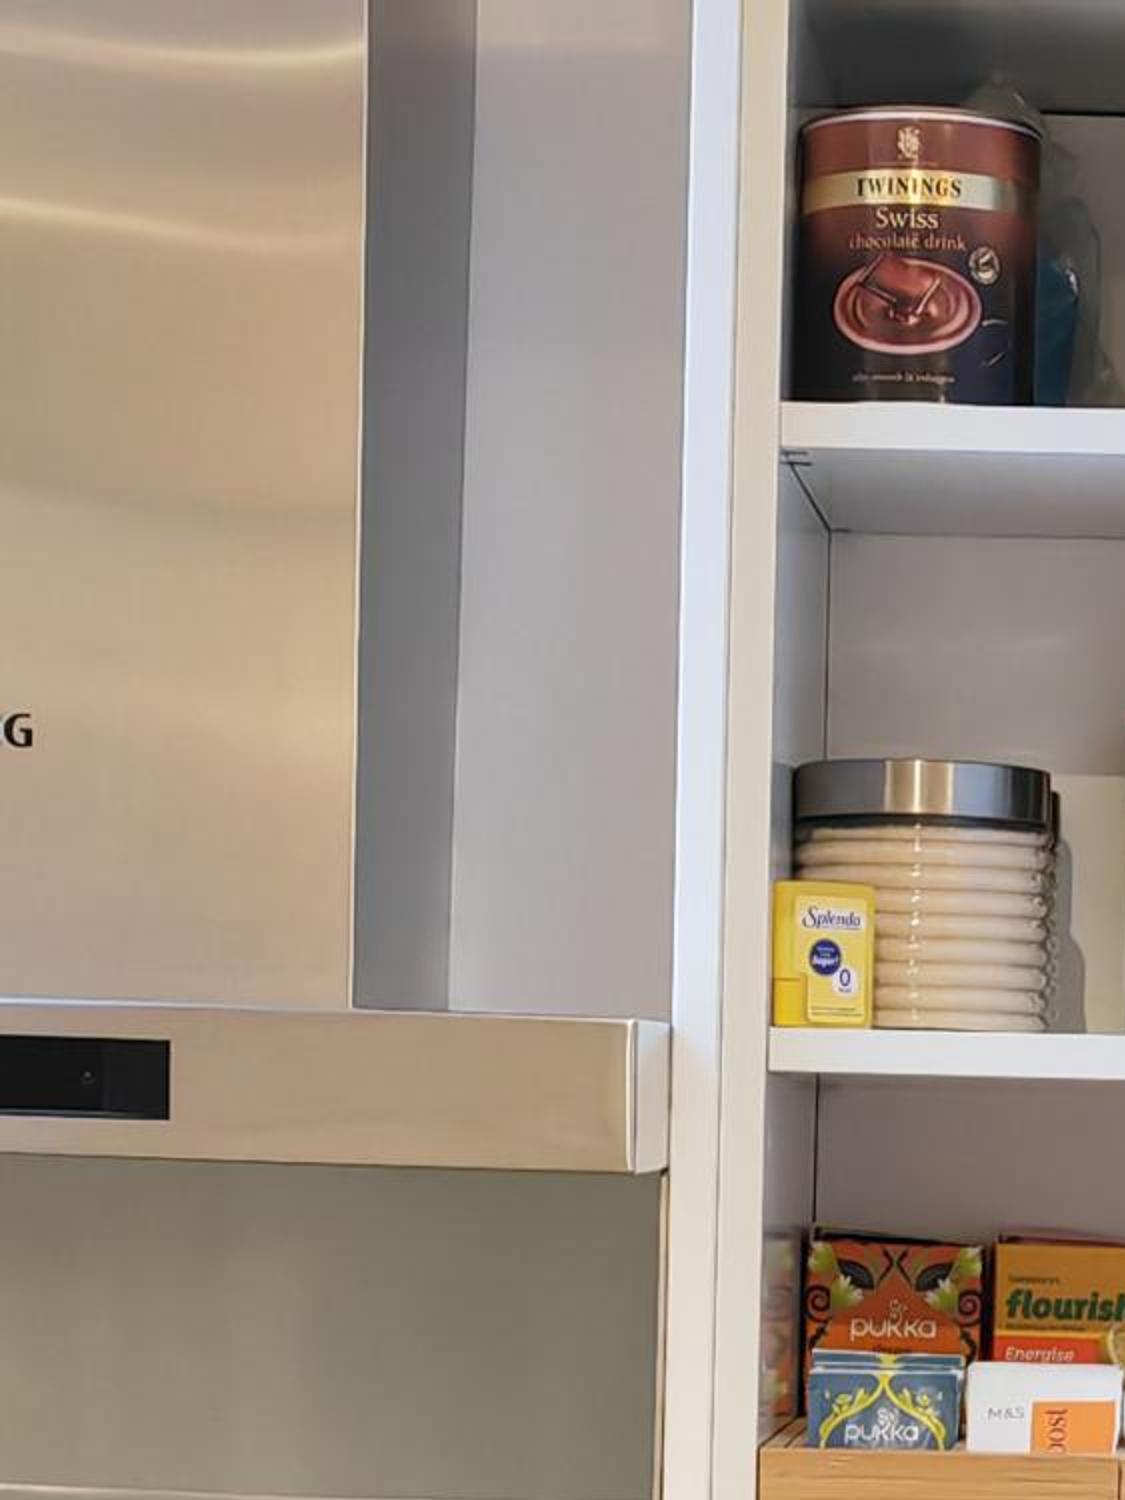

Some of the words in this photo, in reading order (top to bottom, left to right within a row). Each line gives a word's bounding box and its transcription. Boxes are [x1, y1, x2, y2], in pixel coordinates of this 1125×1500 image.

[857, 176, 962, 199] TWININGS
[875, 206, 939, 230] Swiss
[924, 233, 967, 252] drink
[803, 906, 861, 929] Splenda
[850, 1317, 937, 1342] pukka
[1005, 1344, 1075, 1361] Energise
[844, 1423, 919, 1445] pukka
